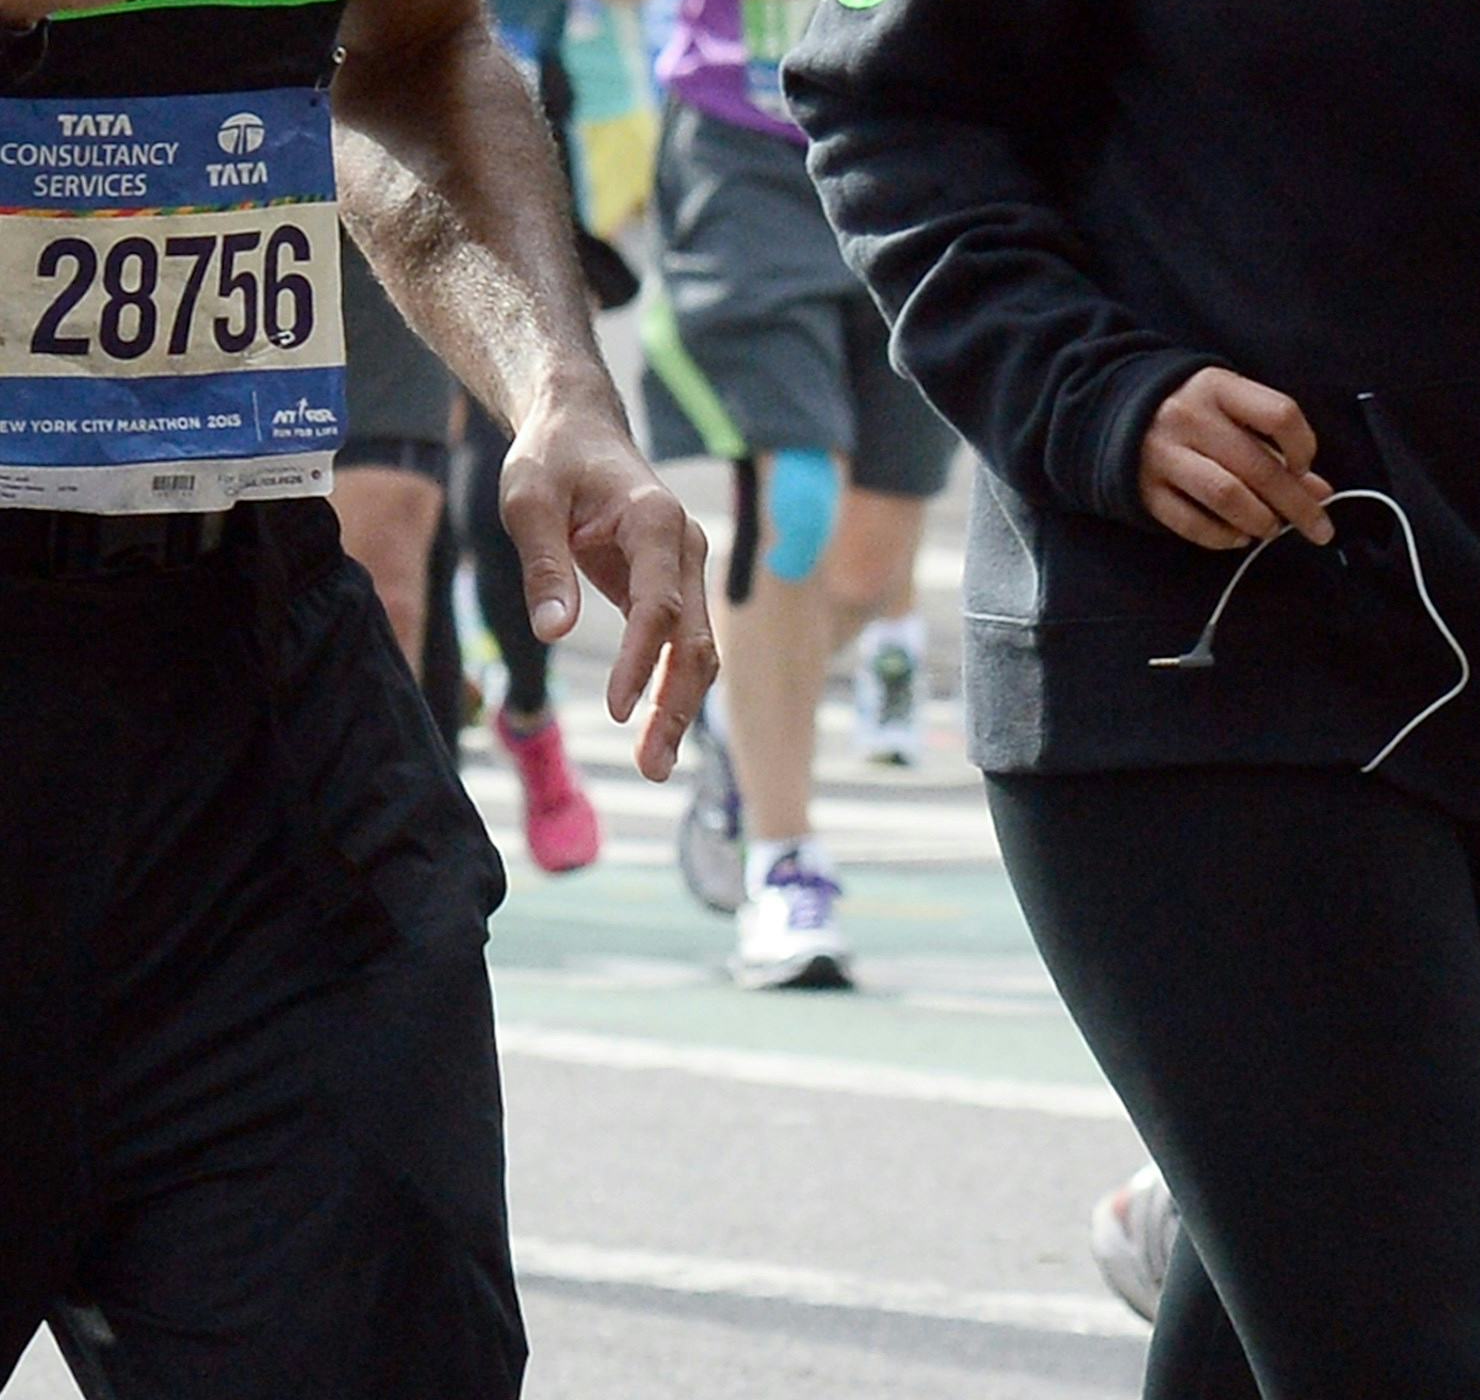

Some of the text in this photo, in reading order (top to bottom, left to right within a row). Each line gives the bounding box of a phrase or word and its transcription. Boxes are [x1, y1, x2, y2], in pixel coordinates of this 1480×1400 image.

[57, 114, 133, 137] TATA
[0, 142, 179, 167] CONSULTANCY
[34, 173, 147, 198] SERVICES
[206, 162, 268, 187] TATA
[30, 224, 314, 360] 28756
[30, 420, 77, 433] YORK
[81, 419, 114, 433] CITY
[116, 416, 201, 432] MARATHON
